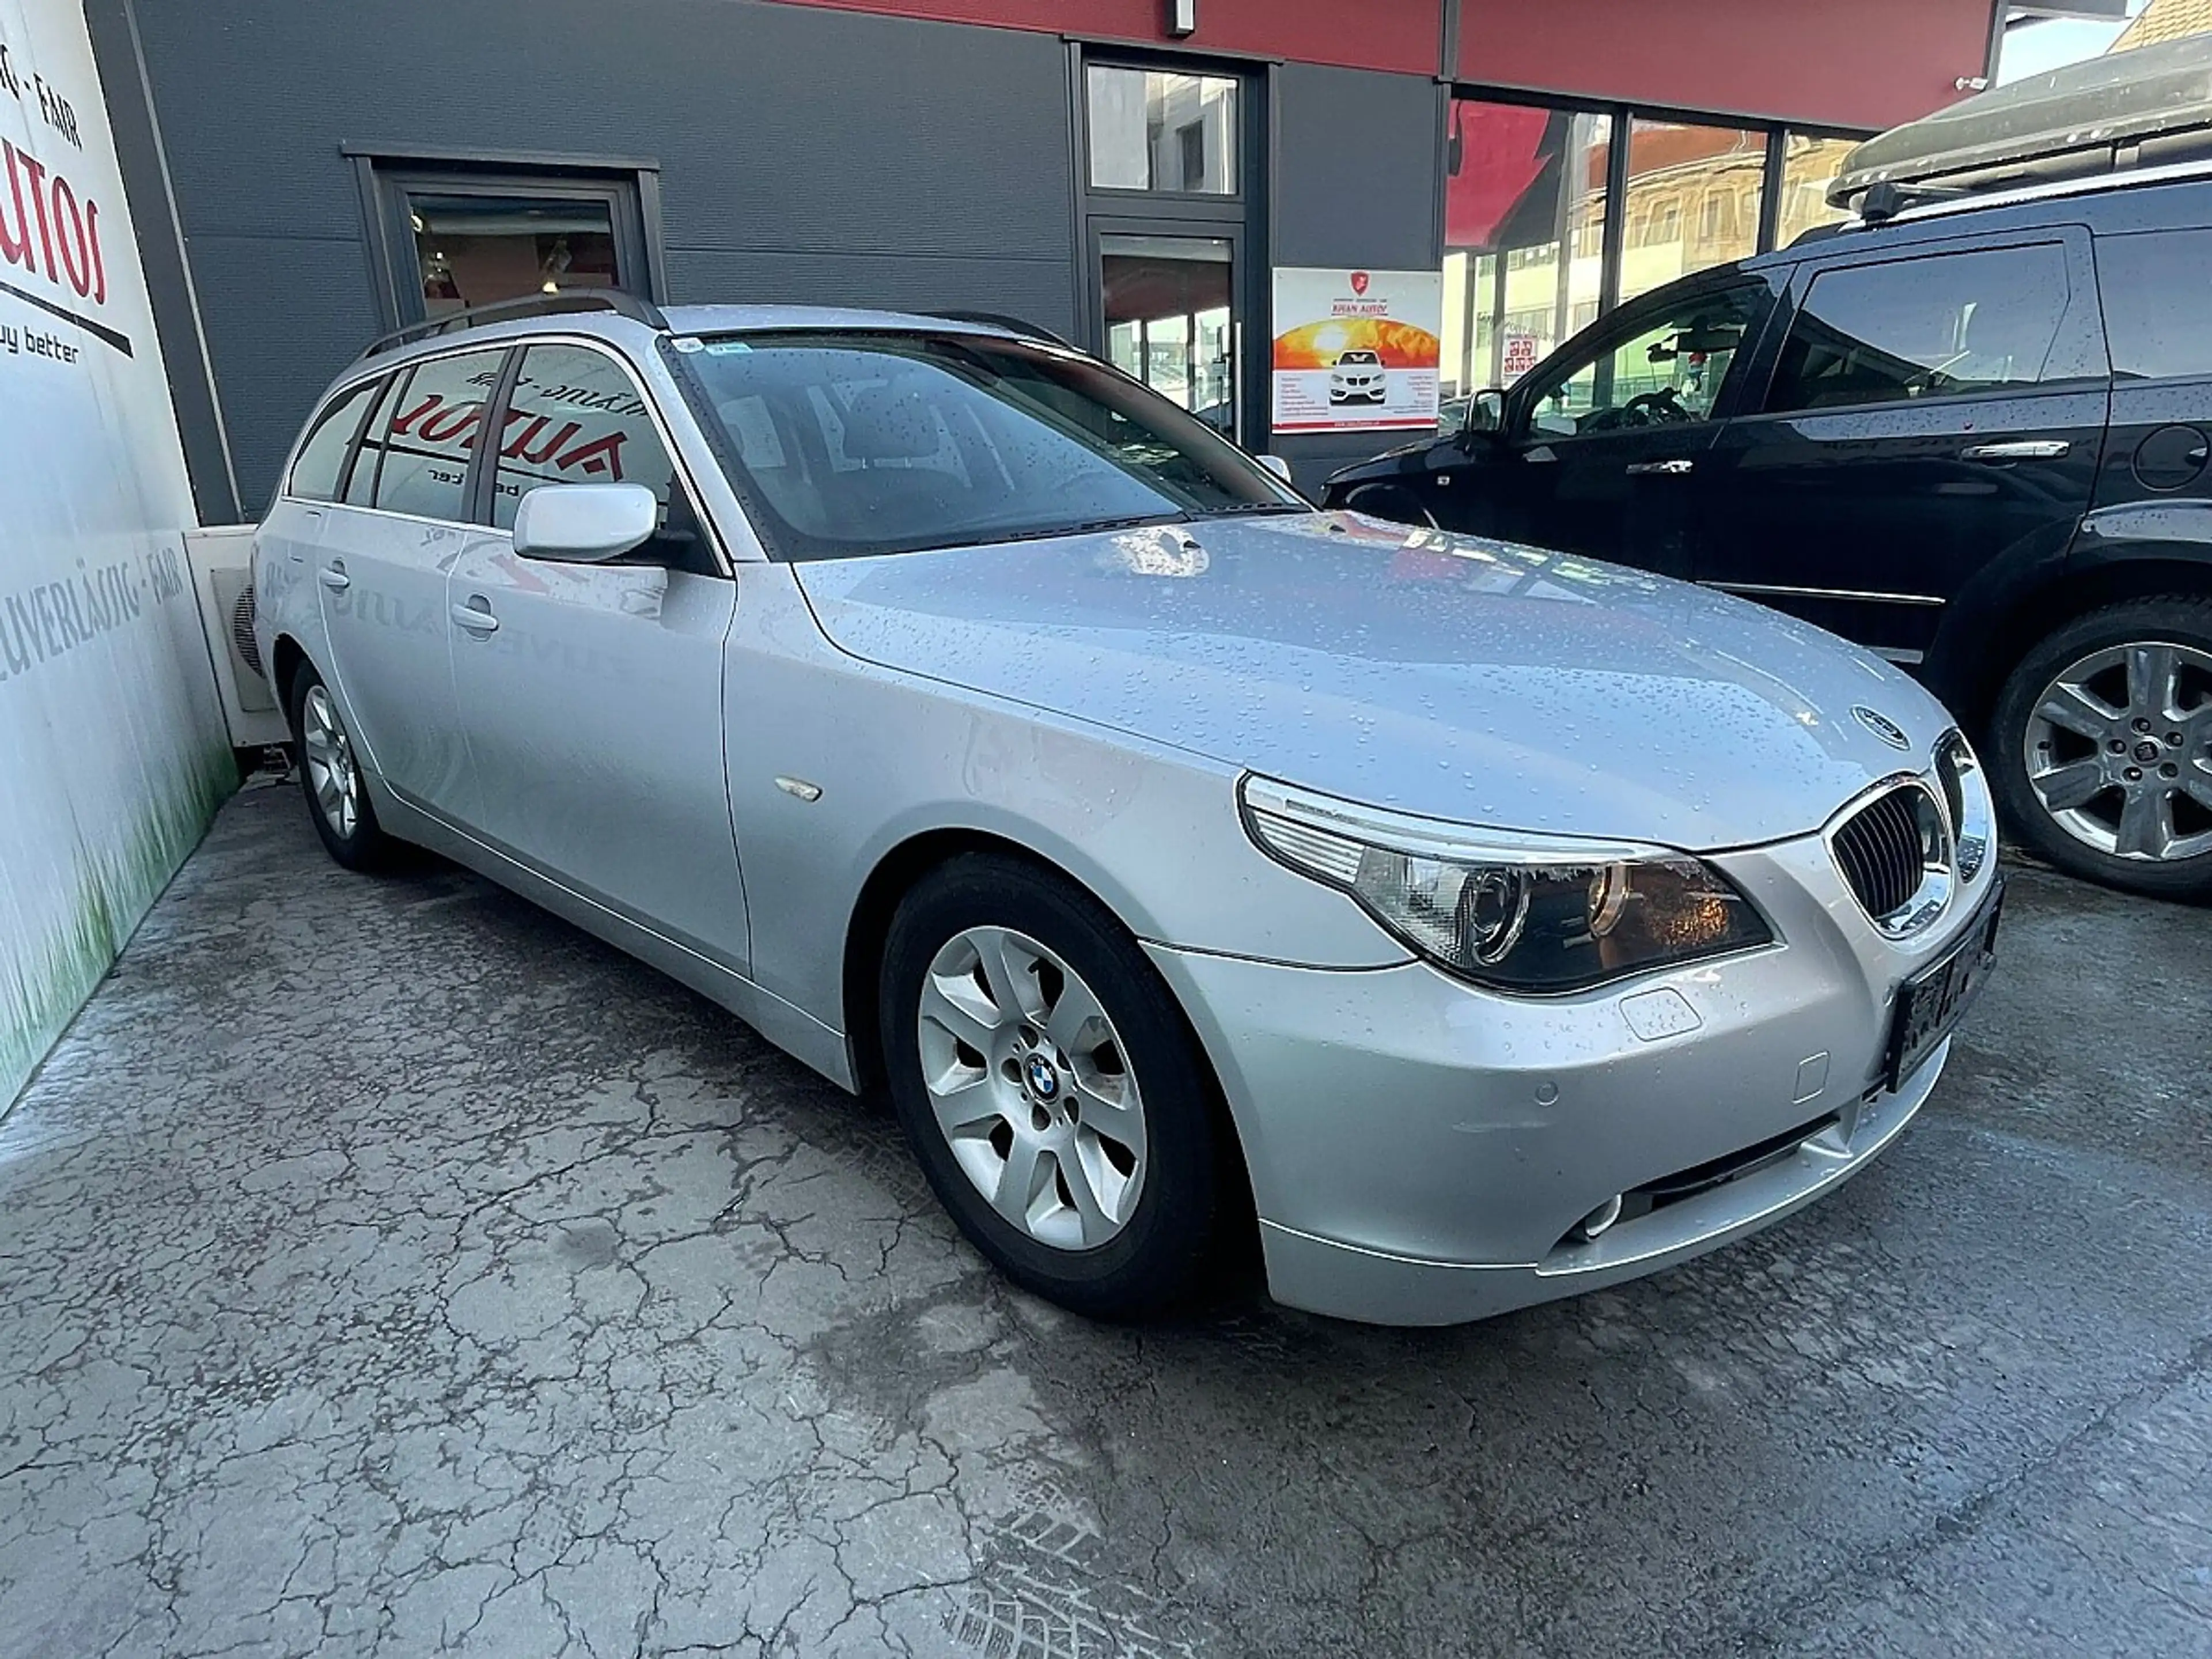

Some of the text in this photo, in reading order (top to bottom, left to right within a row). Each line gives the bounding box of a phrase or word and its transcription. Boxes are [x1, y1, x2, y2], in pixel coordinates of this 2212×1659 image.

[33, 72, 82, 152] FAIR
[24, 325, 79, 364] better
[0, 556, 140, 681] UVERLÄSSIG
